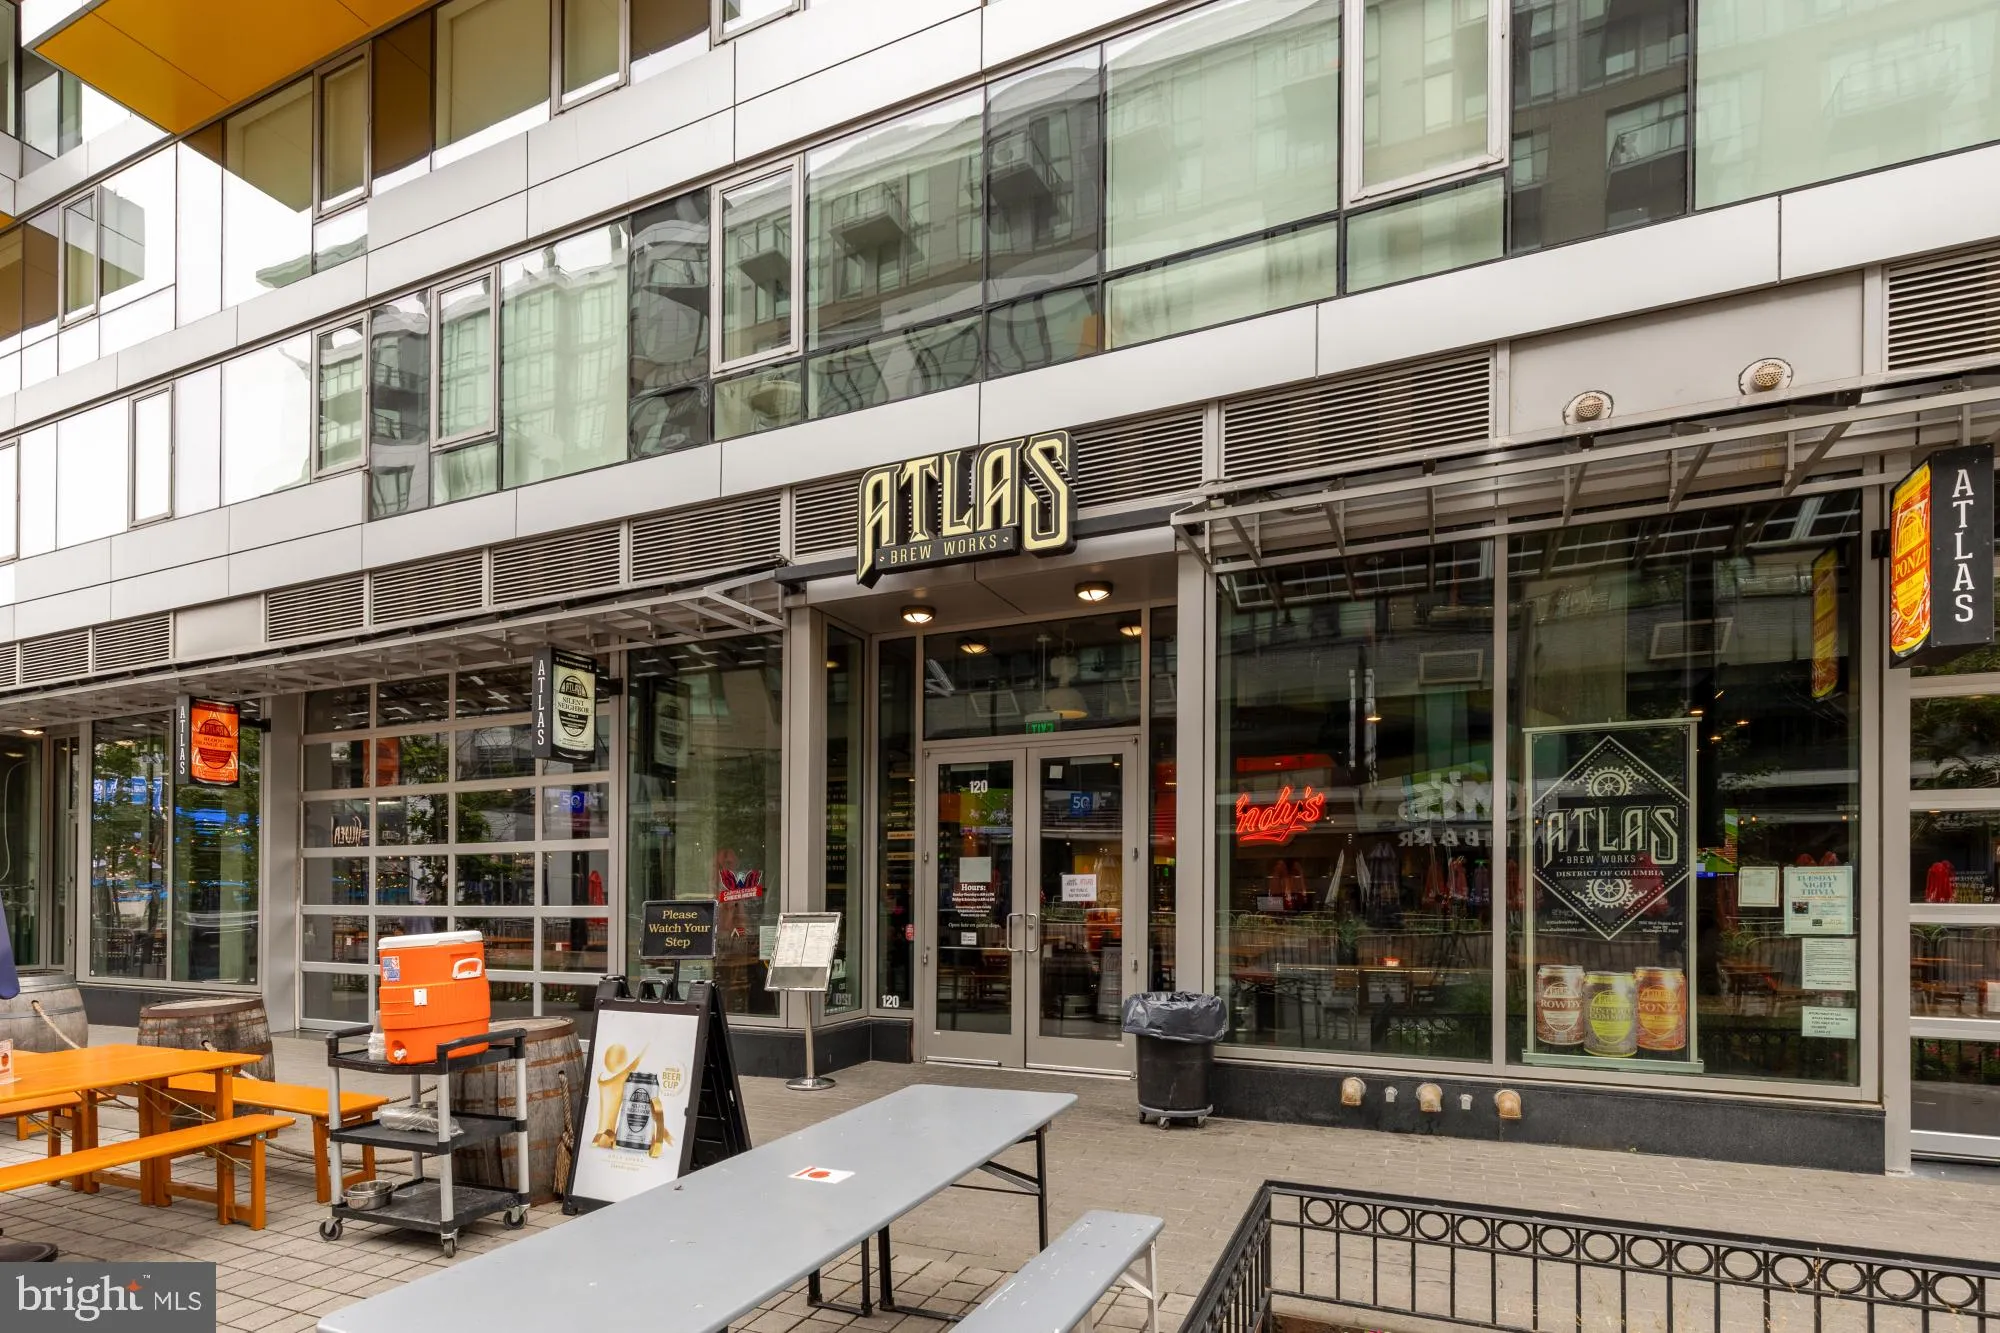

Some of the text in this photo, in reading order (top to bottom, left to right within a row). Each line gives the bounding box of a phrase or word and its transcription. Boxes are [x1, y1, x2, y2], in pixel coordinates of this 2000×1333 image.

[857, 430, 1070, 583] ATLAS
[890, 534, 997, 564] BREW WORKS
[1952, 469, 1975, 623] ATLAS
[1894, 543, 1927, 581] PONZI
[537, 659, 546, 746] ATLAS
[562, 696, 585, 706] SILENT
[557, 702, 590, 713] NEIGHBOR
[969, 780, 988, 793] 120
[1543, 805, 1680, 868] ATLAS
[1566, 854, 1636, 864] BREW WORKS
[1614, 869, 1665, 877] COLUMBIA
[961, 883, 987, 891] Hours:
[662, 910, 698, 920] Please
[649, 923, 711, 933] Watch Your
[665, 938, 691, 949] Step
[882, 995, 899, 1008] 120
[1540, 999, 1582, 1009] ROWDY
[1638, 1002, 1680, 1013] PONZI
[662, 1071, 681, 1082] BEER
[662, 1081, 679, 1090] CUP
